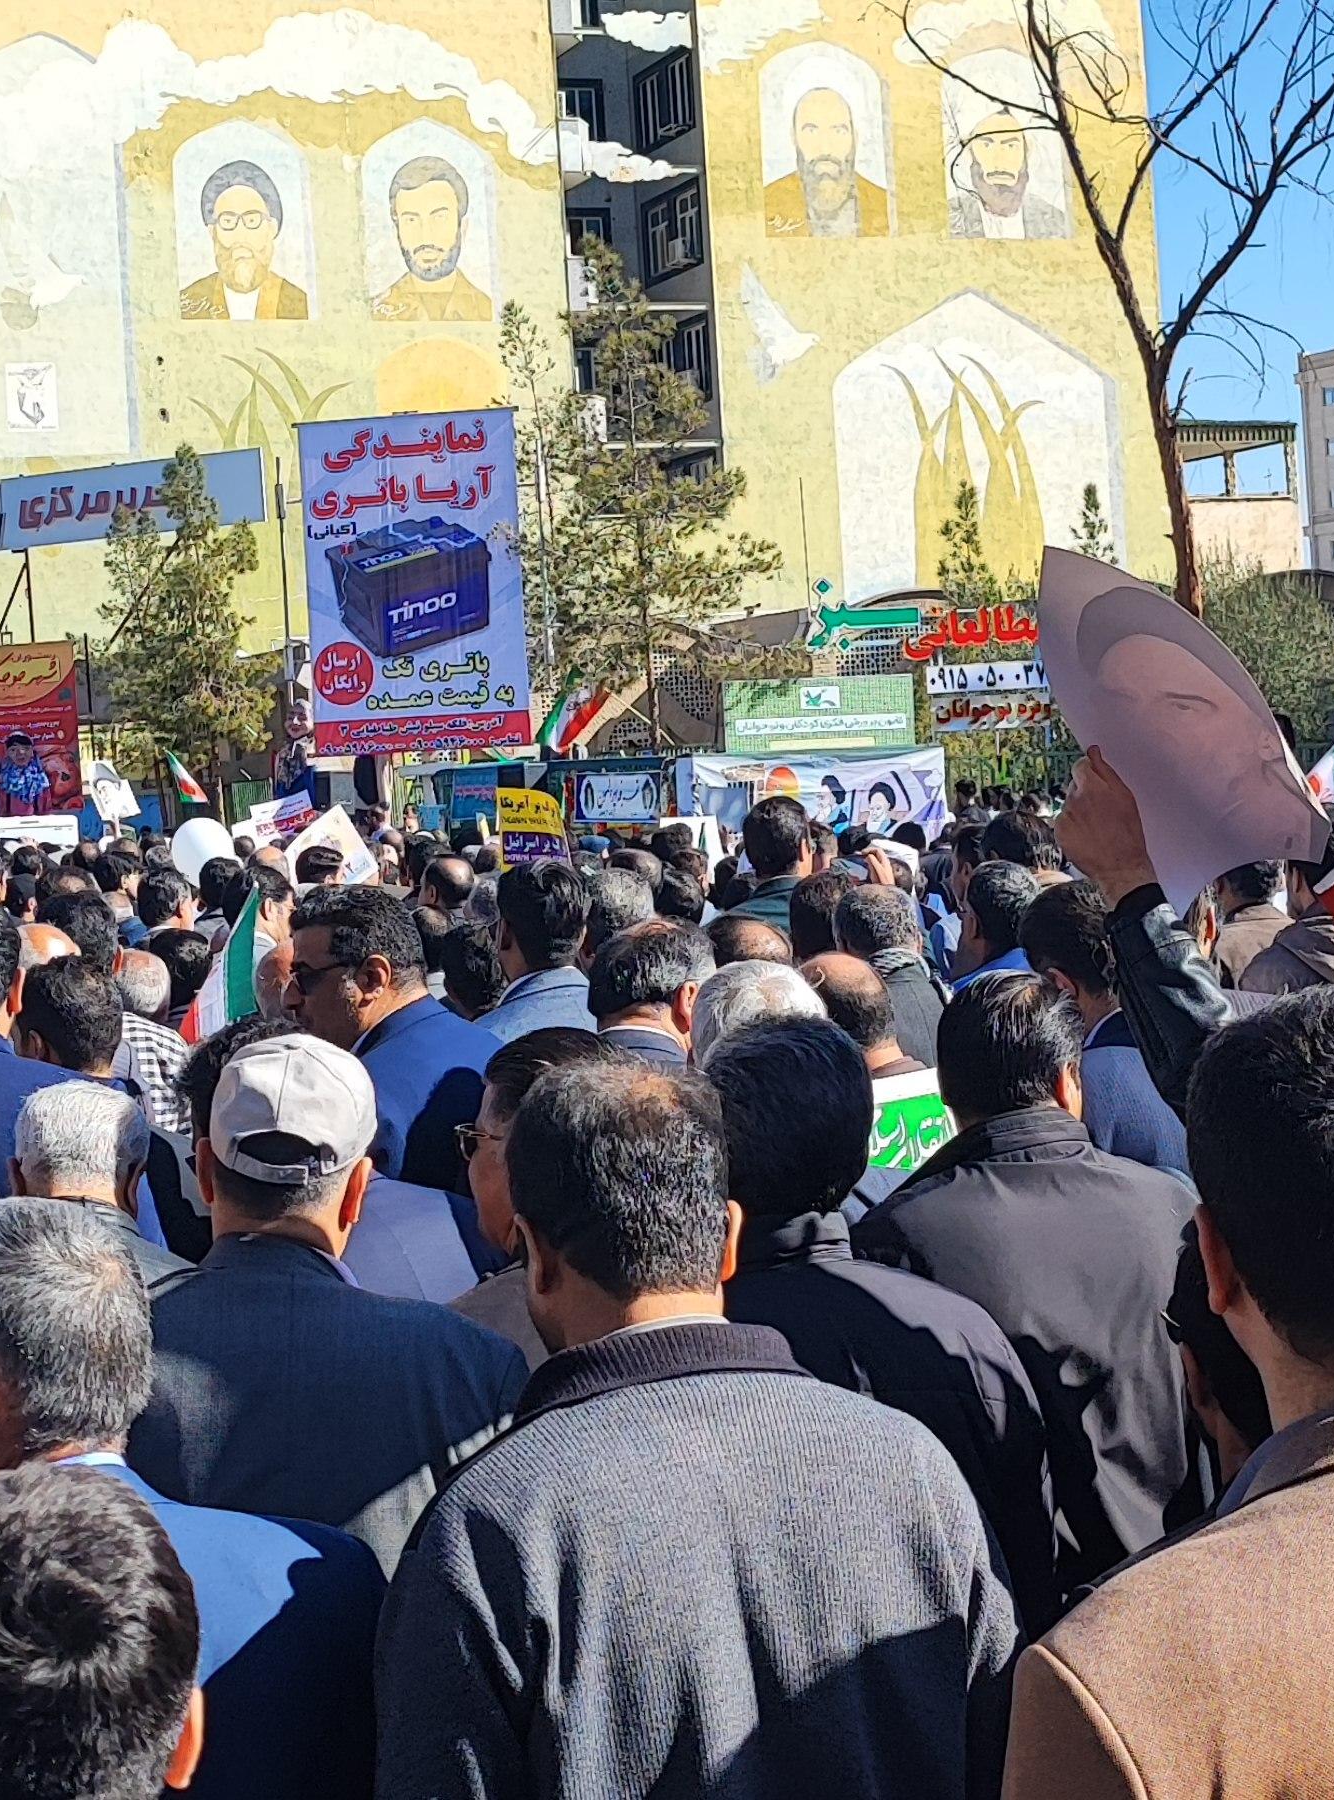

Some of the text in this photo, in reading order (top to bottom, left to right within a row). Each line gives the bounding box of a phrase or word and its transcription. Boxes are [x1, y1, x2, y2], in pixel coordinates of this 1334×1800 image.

[322, 418, 487, 474] نمایندگی
[310, 464, 496, 520] آریا باتری
[17, 485, 111, 531] مرکزی
[24, 660, 57, 687] شهر
[320, 650, 362, 673] ارسال
[381, 650, 490, 682] باتری تک
[321, 673, 367, 696] رایگان
[366, 679, 516, 711] به قیمت عمده
[499, 795, 530, 814] آمریکا
[503, 832, 540, 853] اسرائیل
